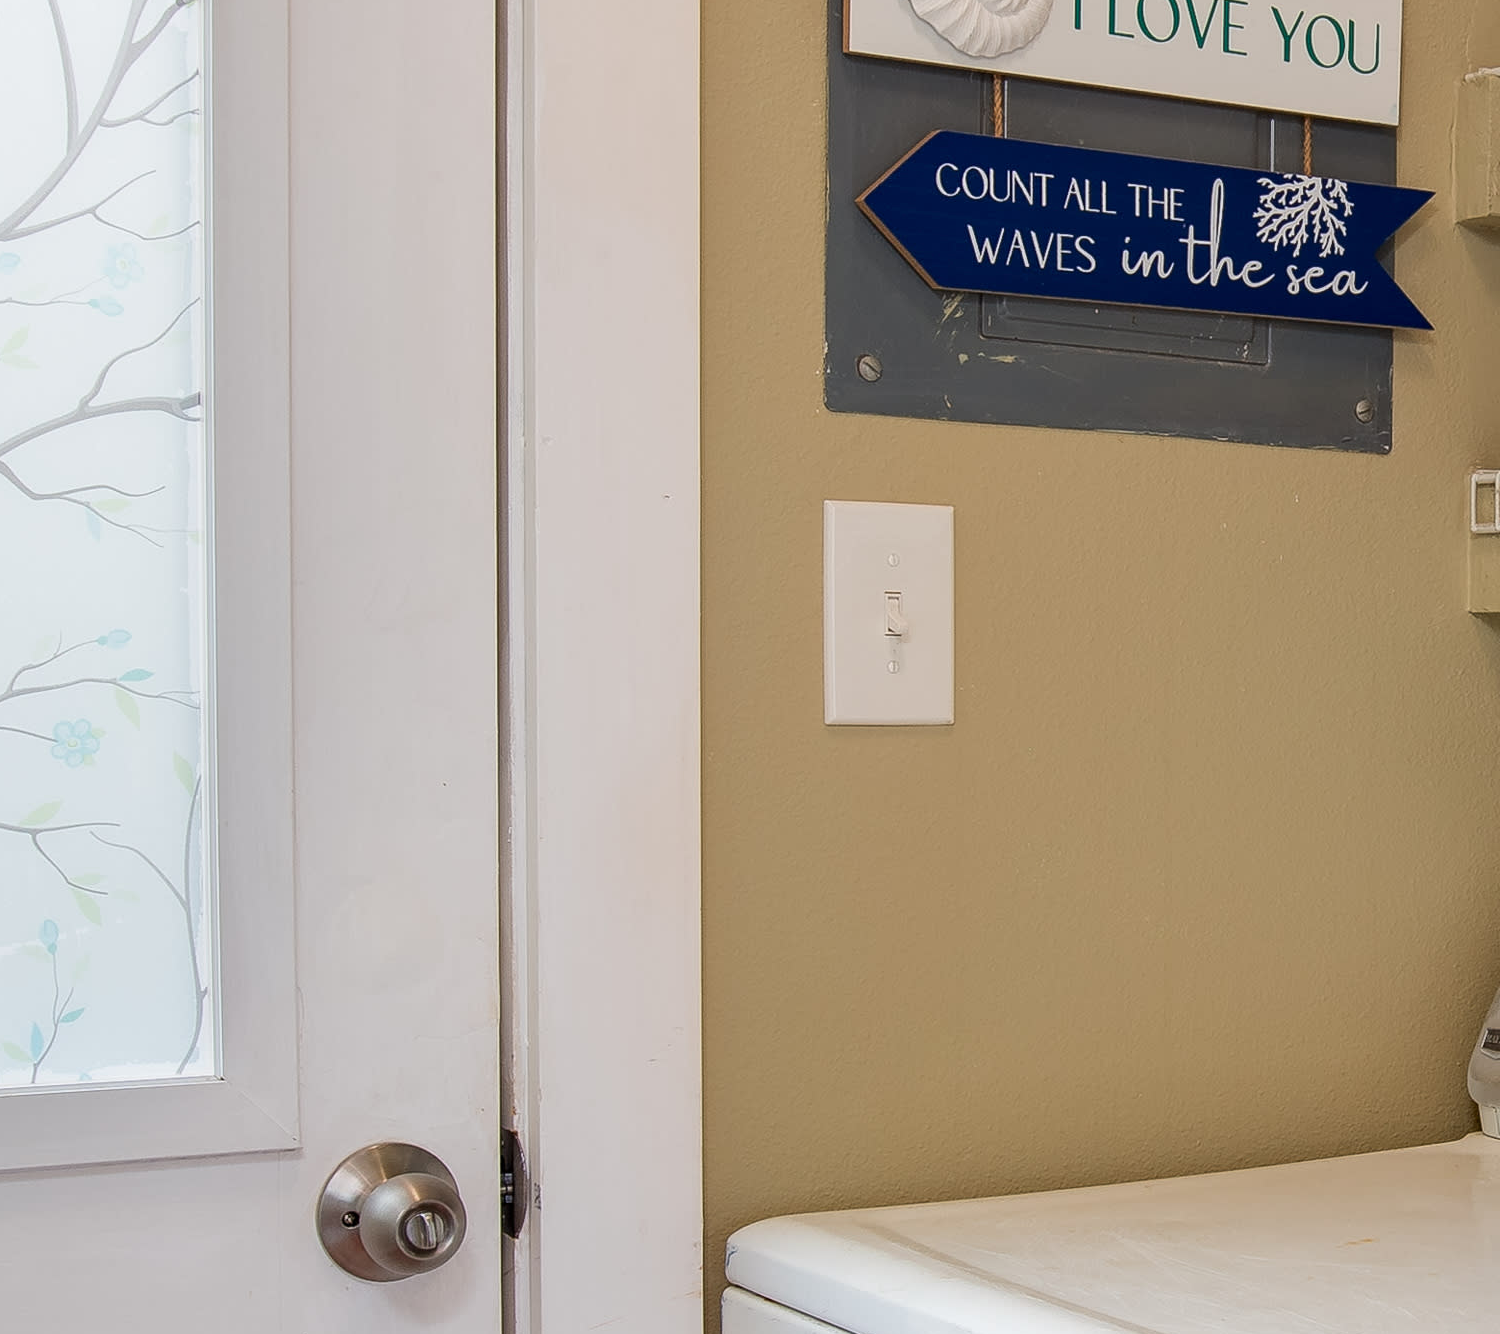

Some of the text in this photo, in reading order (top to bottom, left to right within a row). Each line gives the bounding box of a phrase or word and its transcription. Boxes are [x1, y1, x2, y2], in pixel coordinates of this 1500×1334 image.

[1271, 5, 1383, 76] YOU
[935, 162, 1187, 223] COUNT ALL THE
[967, 177, 1369, 297] WAVES in the sea
